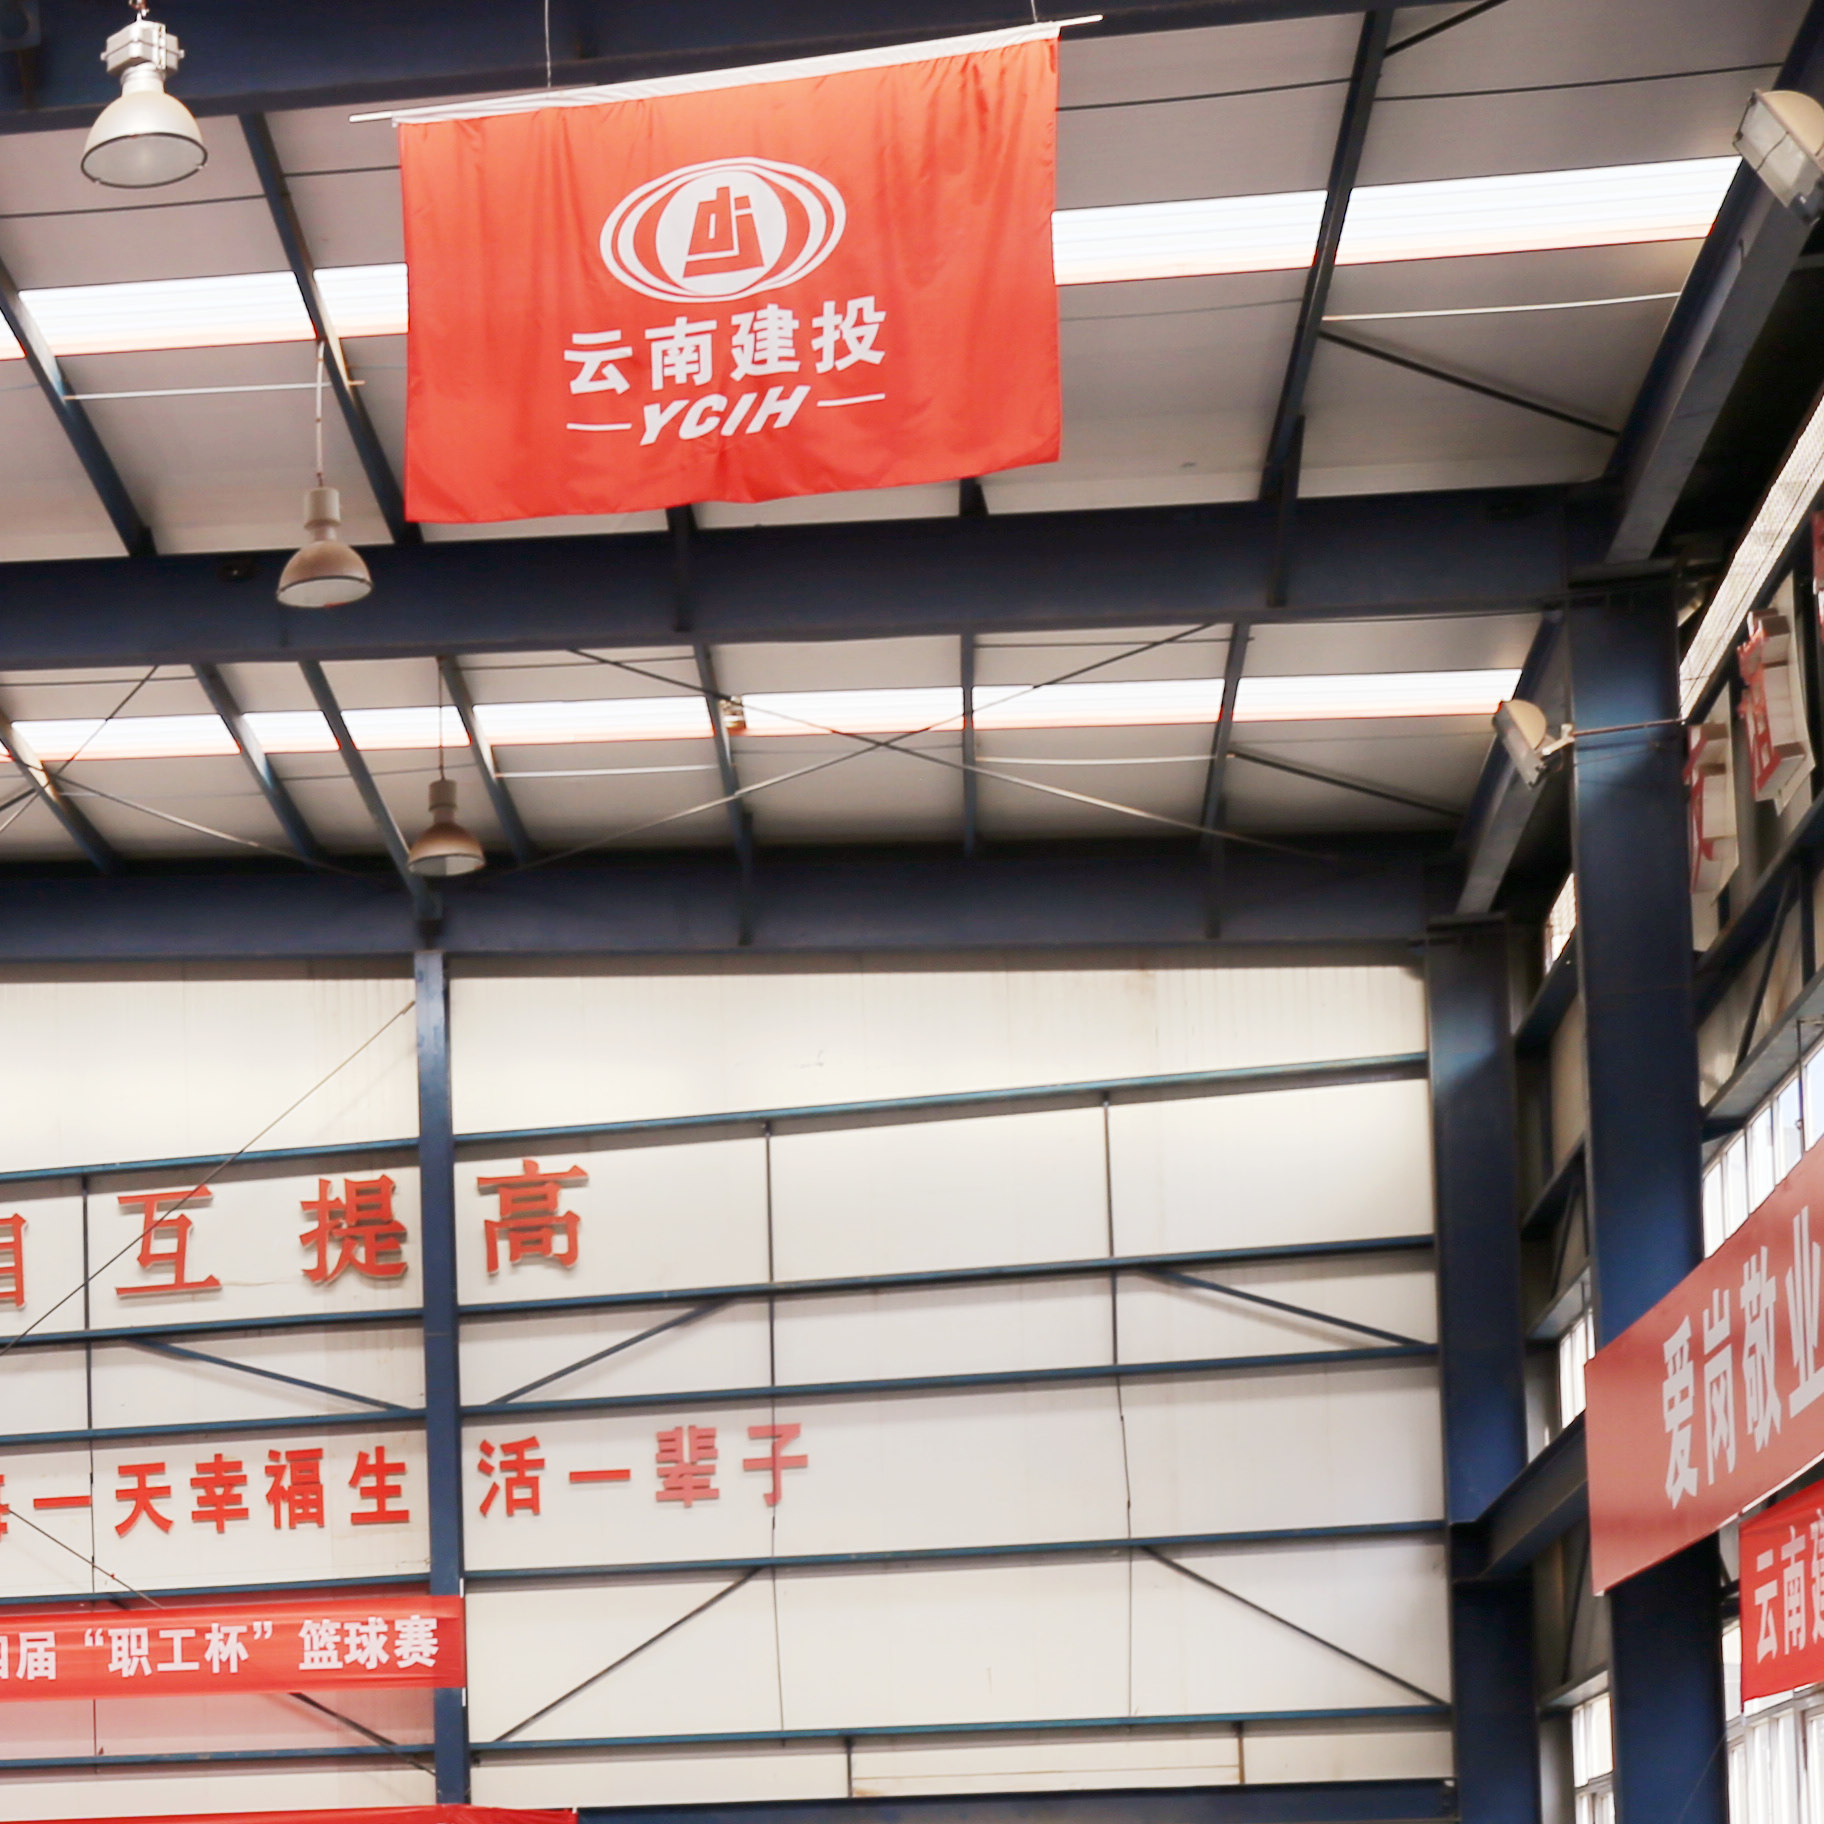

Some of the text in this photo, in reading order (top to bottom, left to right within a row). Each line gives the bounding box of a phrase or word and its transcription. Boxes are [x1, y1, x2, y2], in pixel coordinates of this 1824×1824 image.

[563, 296, 887, 396] 云南建投
[639, 385, 812, 447] YCIH
[1662, 1205, 1824, 1511] 爱岗敬业
